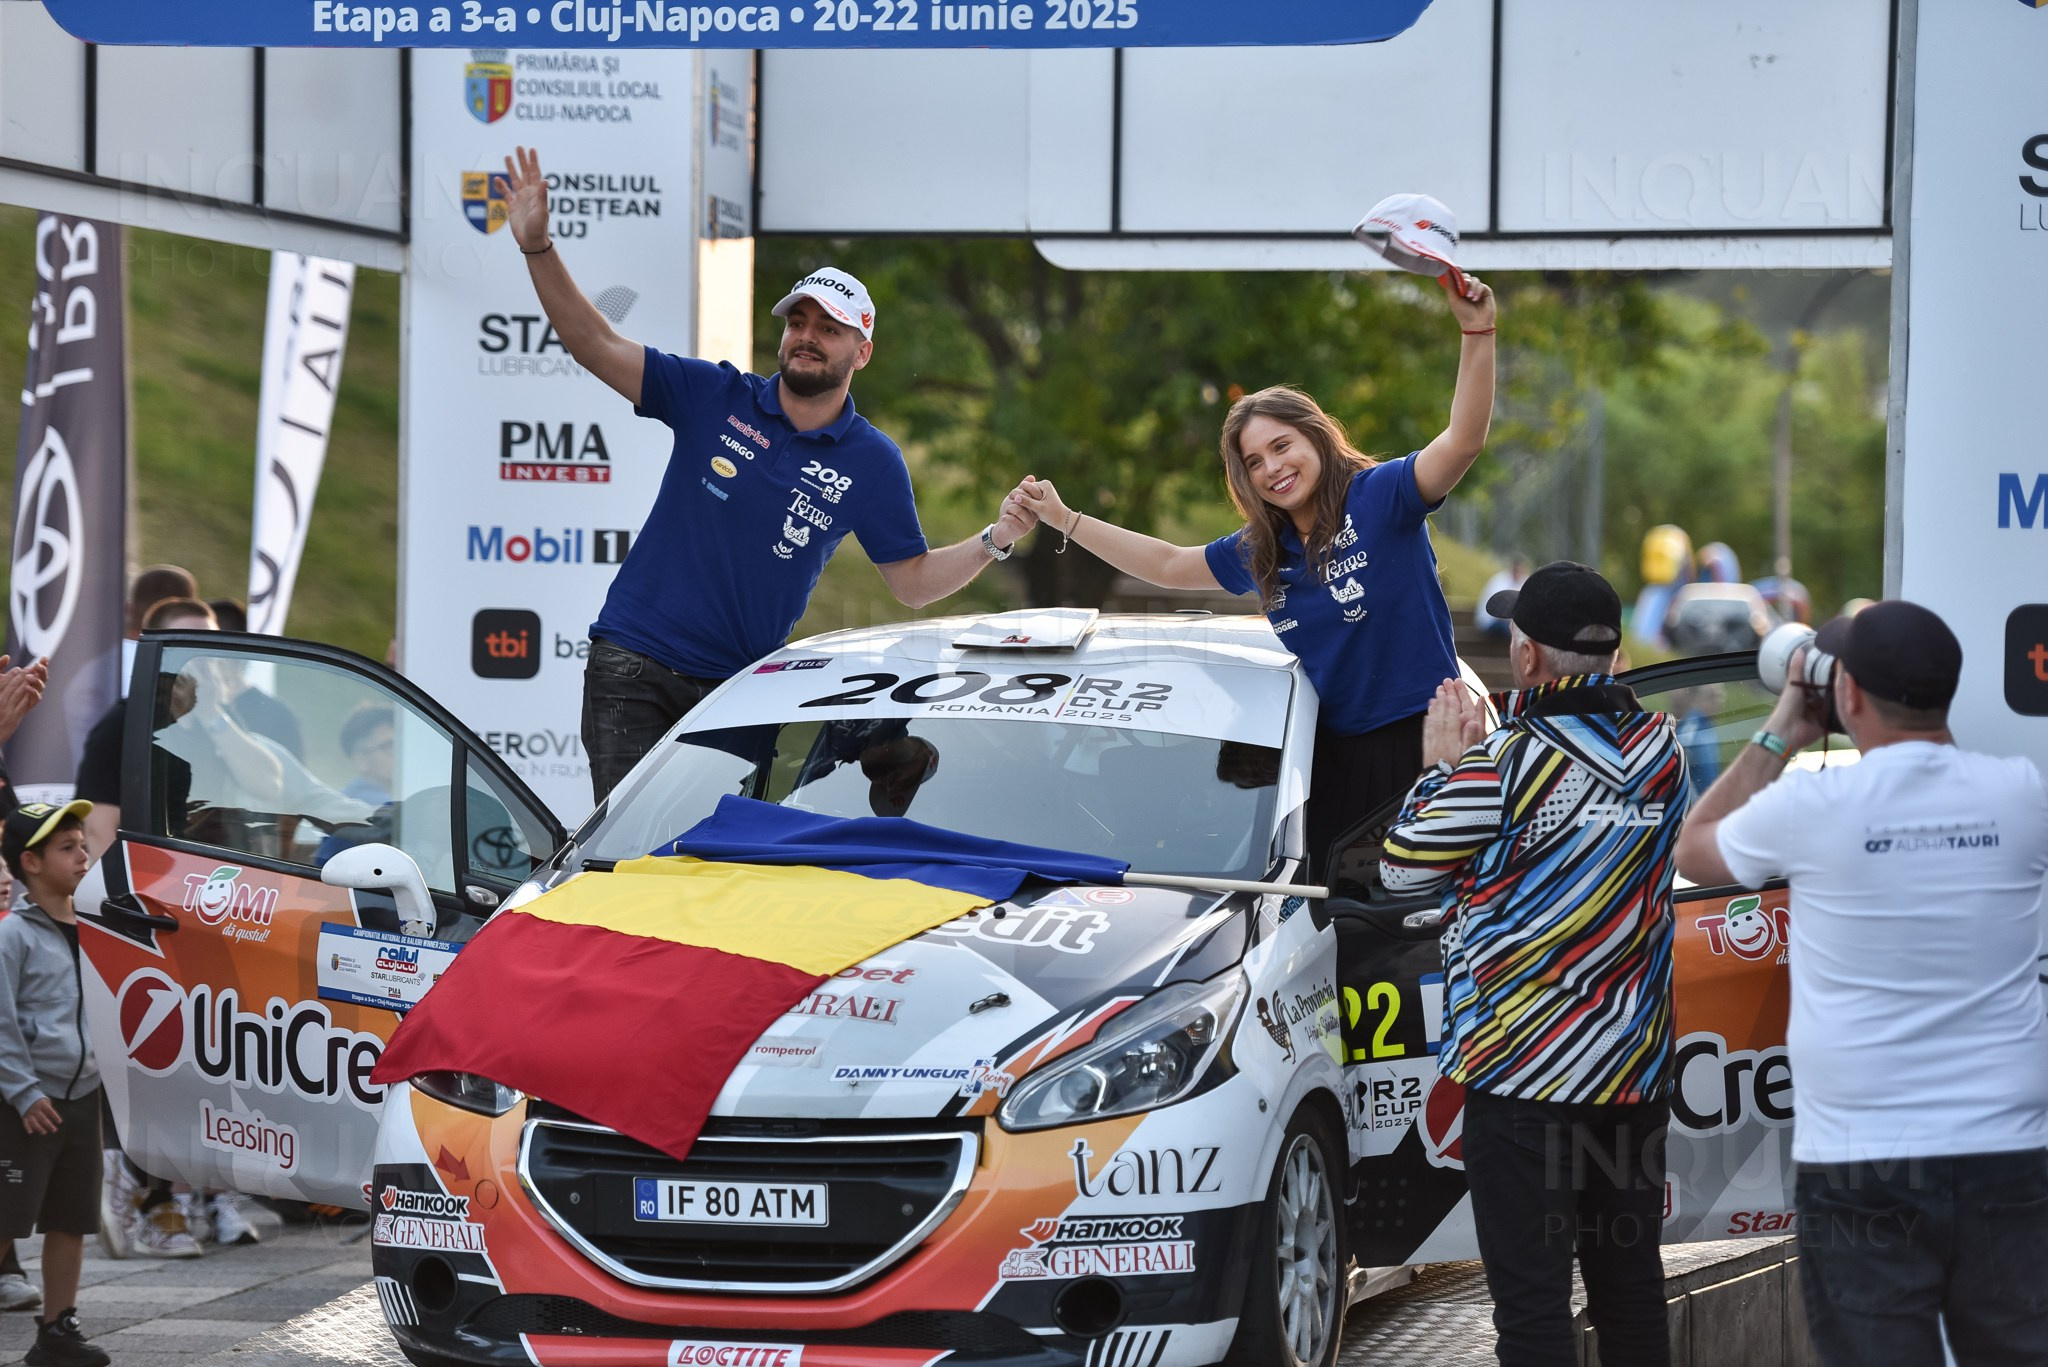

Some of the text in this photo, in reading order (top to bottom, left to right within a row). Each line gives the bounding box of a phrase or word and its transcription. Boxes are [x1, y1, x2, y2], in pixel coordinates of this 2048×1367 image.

[313, 0, 1139, 42] Etapa a 3-a Cluj-Napoca 20-22 iunie 2025
[515, 51, 599, 72] PRIMĂRIA
[516, 78, 662, 100] CONSILIUL LOCAL
[515, 102, 632, 122] CLUJ-NAPOCA
[543, 173, 662, 194] ONSILIUL
[478, 312, 570, 354] STA
[478, 356, 588, 377] LUBRICAN
[501, 420, 610, 461] PMA
[725, 436, 755, 460] URGO
[504, 464, 609, 481] INVEST
[800, 460, 853, 491] 208
[822, 493, 840, 504] CUP
[824, 485, 843, 500] R2
[787, 487, 833, 526] Termo
[467, 525, 584, 564] Mobil
[783, 522, 810, 545] VERLA
[1341, 536, 1359, 550] CUP
[1331, 582, 1365, 601] VERLA
[485, 630, 592, 659] tbi ba
[798, 671, 1173, 708] 208 R2
[928, 703, 1132, 722] ROMANIA 2025
[1069, 696, 1162, 712] CUP
[476, 729, 578, 760] EROVI
[1577, 803, 1665, 827] FRAS
[1896, 834, 2000, 852] ALPHATAURI
[184, 873, 279, 925] TOMI
[938, 908, 1100, 950] edit
[835, 966, 915, 984] et
[788, 993, 901, 1023] ERALI
[1295, 977, 1336, 1018] Provincia
[194, 992, 388, 1105] UniCre
[755, 1045, 816, 1058] rompetrol
[1373, 1077, 1421, 1101] R2
[1671, 1040, 1795, 1130] Cre
[1375, 1100, 1421, 1117] CUP
[1375, 1117, 1412, 1129] 2025
[205, 1107, 295, 1170] Leasing
[1072, 1141, 1223, 1198] tanz
[640, 1200, 655, 1215] RO
[668, 1185, 815, 1219] IF 80 ATM
[394, 1217, 487, 1251] GENERALI
[1727, 1210, 1797, 1235] Star
[1051, 1243, 1195, 1276] GENERALI
[677, 1345, 793, 1367] LOCTITE
